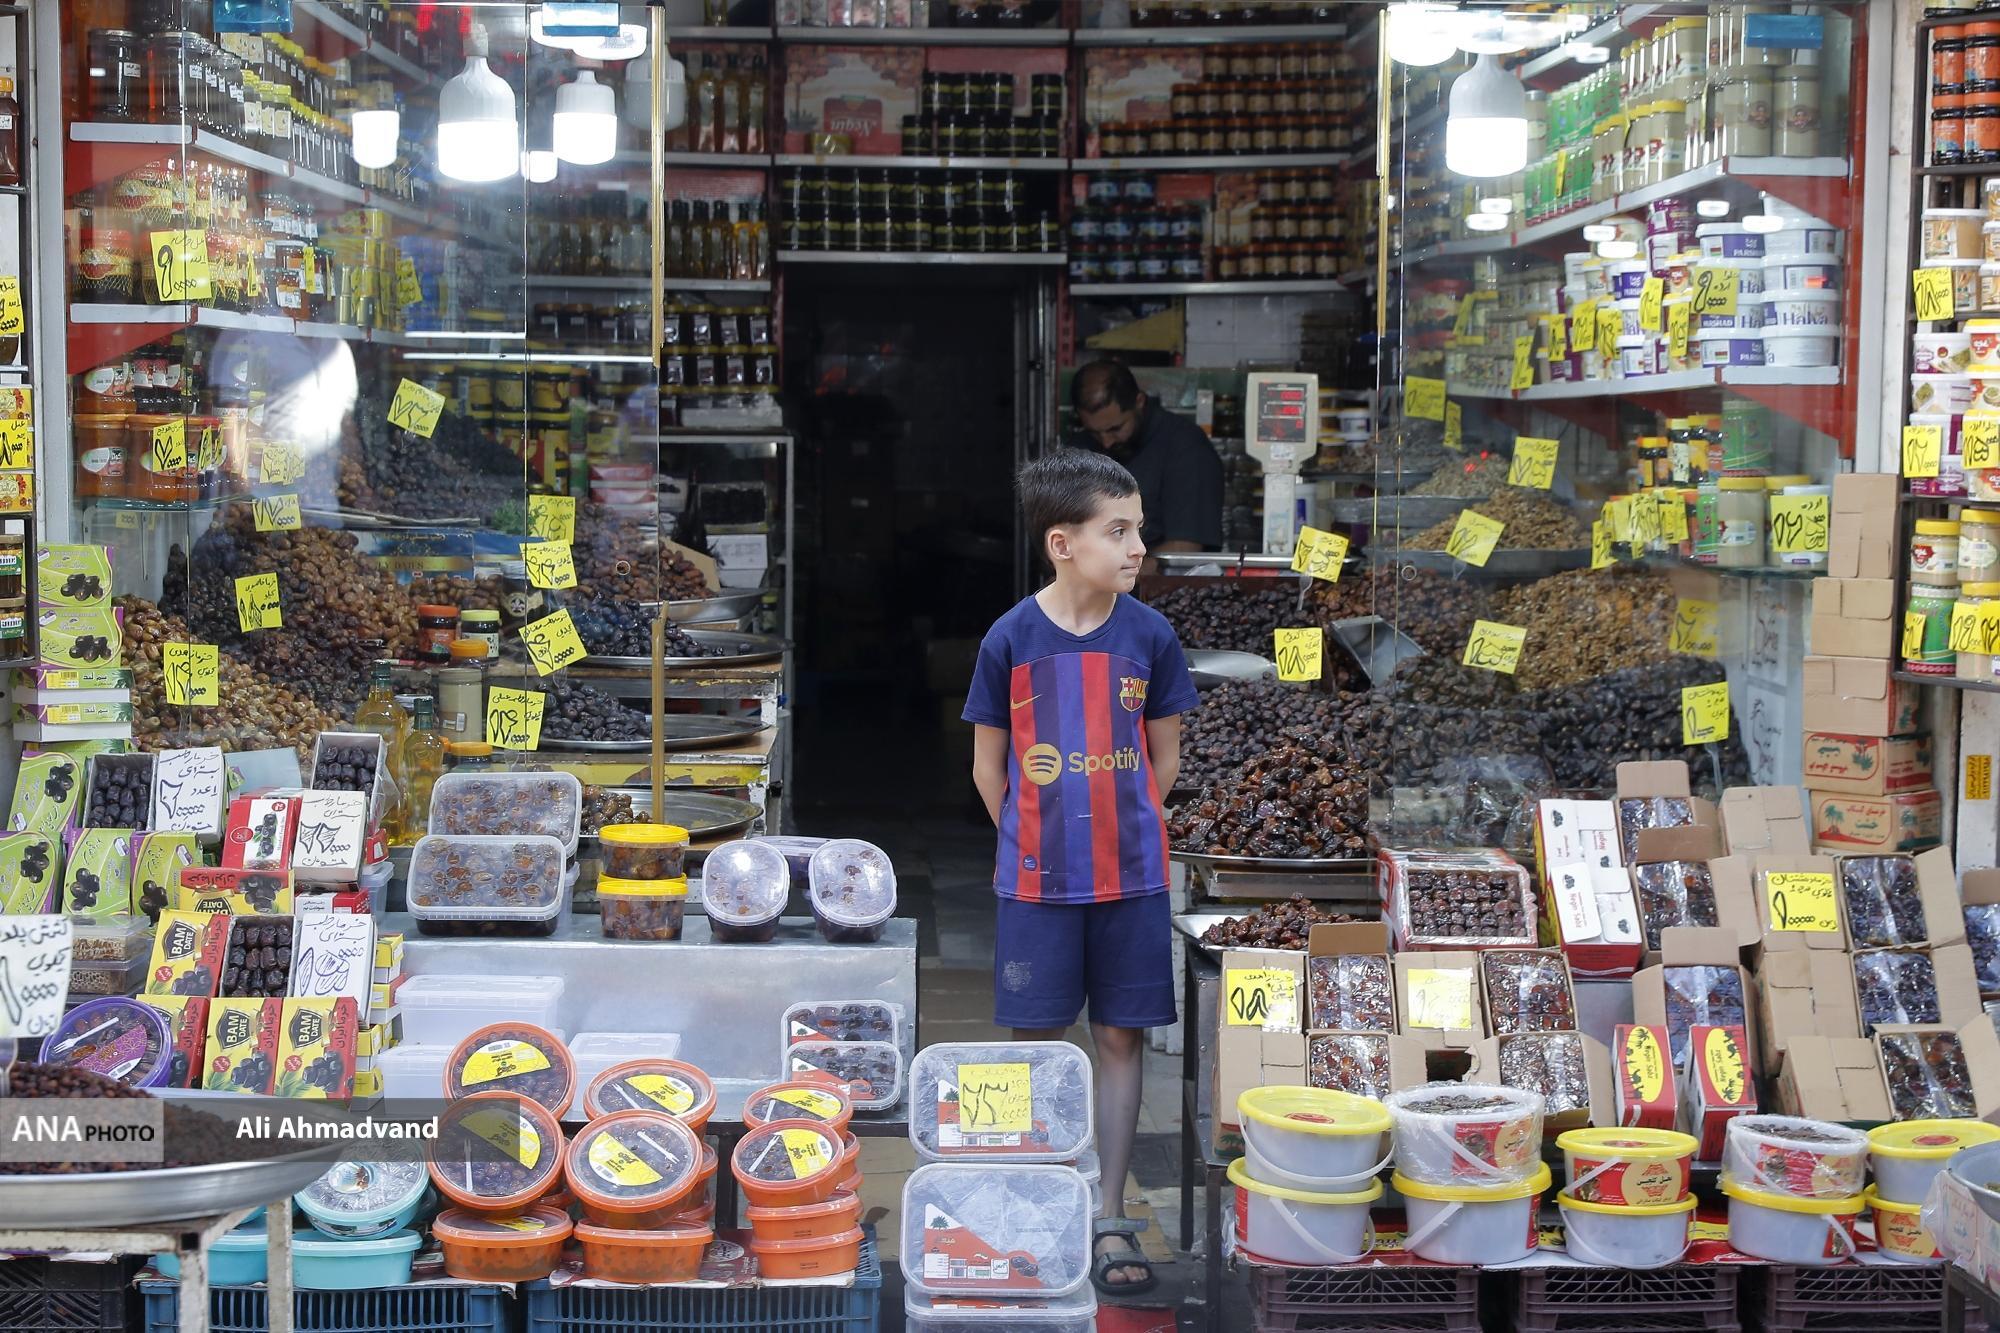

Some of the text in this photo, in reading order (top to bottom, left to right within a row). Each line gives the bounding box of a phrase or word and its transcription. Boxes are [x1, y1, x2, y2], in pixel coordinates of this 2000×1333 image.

[1068, 747, 1140, 777] Spotify
[203, 901, 223, 909] DATE
[172, 927, 195, 956] BAM DATE
[226, 1014, 249, 1043] BAM DATE
[298, 1014, 321, 1043] BAM DATE
